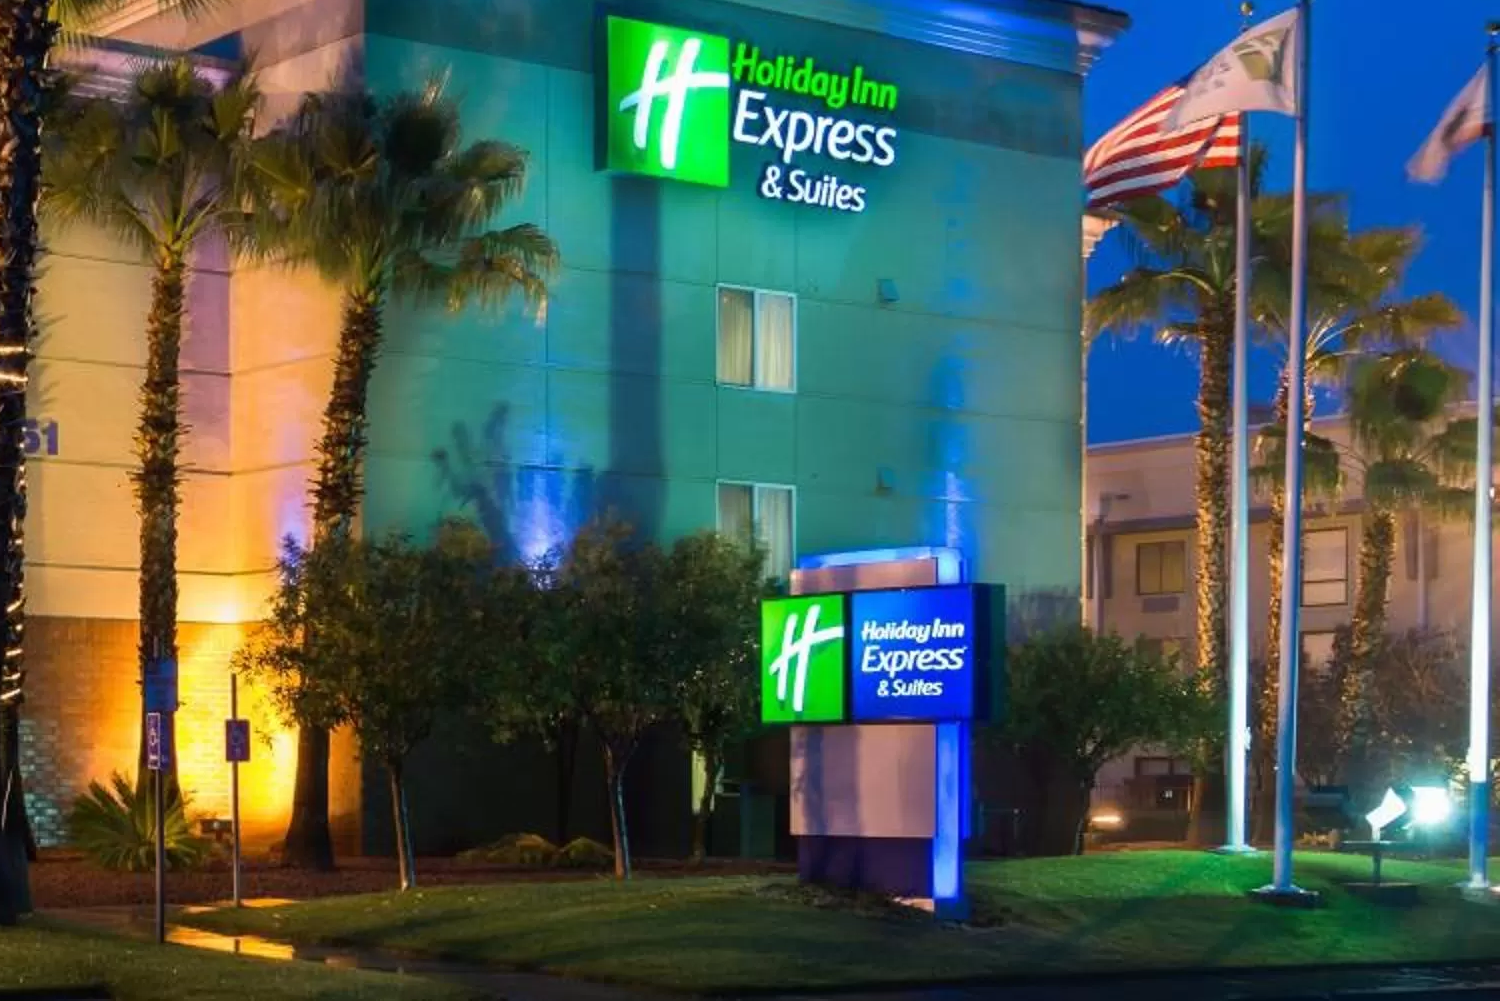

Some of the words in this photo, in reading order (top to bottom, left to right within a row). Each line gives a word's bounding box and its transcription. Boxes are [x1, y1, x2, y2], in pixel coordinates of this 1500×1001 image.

[732, 42, 849, 109] Holiday
[851, 65, 898, 110] Inn
[733, 89, 897, 166] Express
[761, 165, 783, 199] &
[787, 169, 866, 212] Suites
[861, 619, 931, 644] Holiday
[932, 617, 965, 638] Inn
[861, 645, 965, 679] Express
[877, 679, 889, 697] &
[891, 679, 944, 697] Suites
